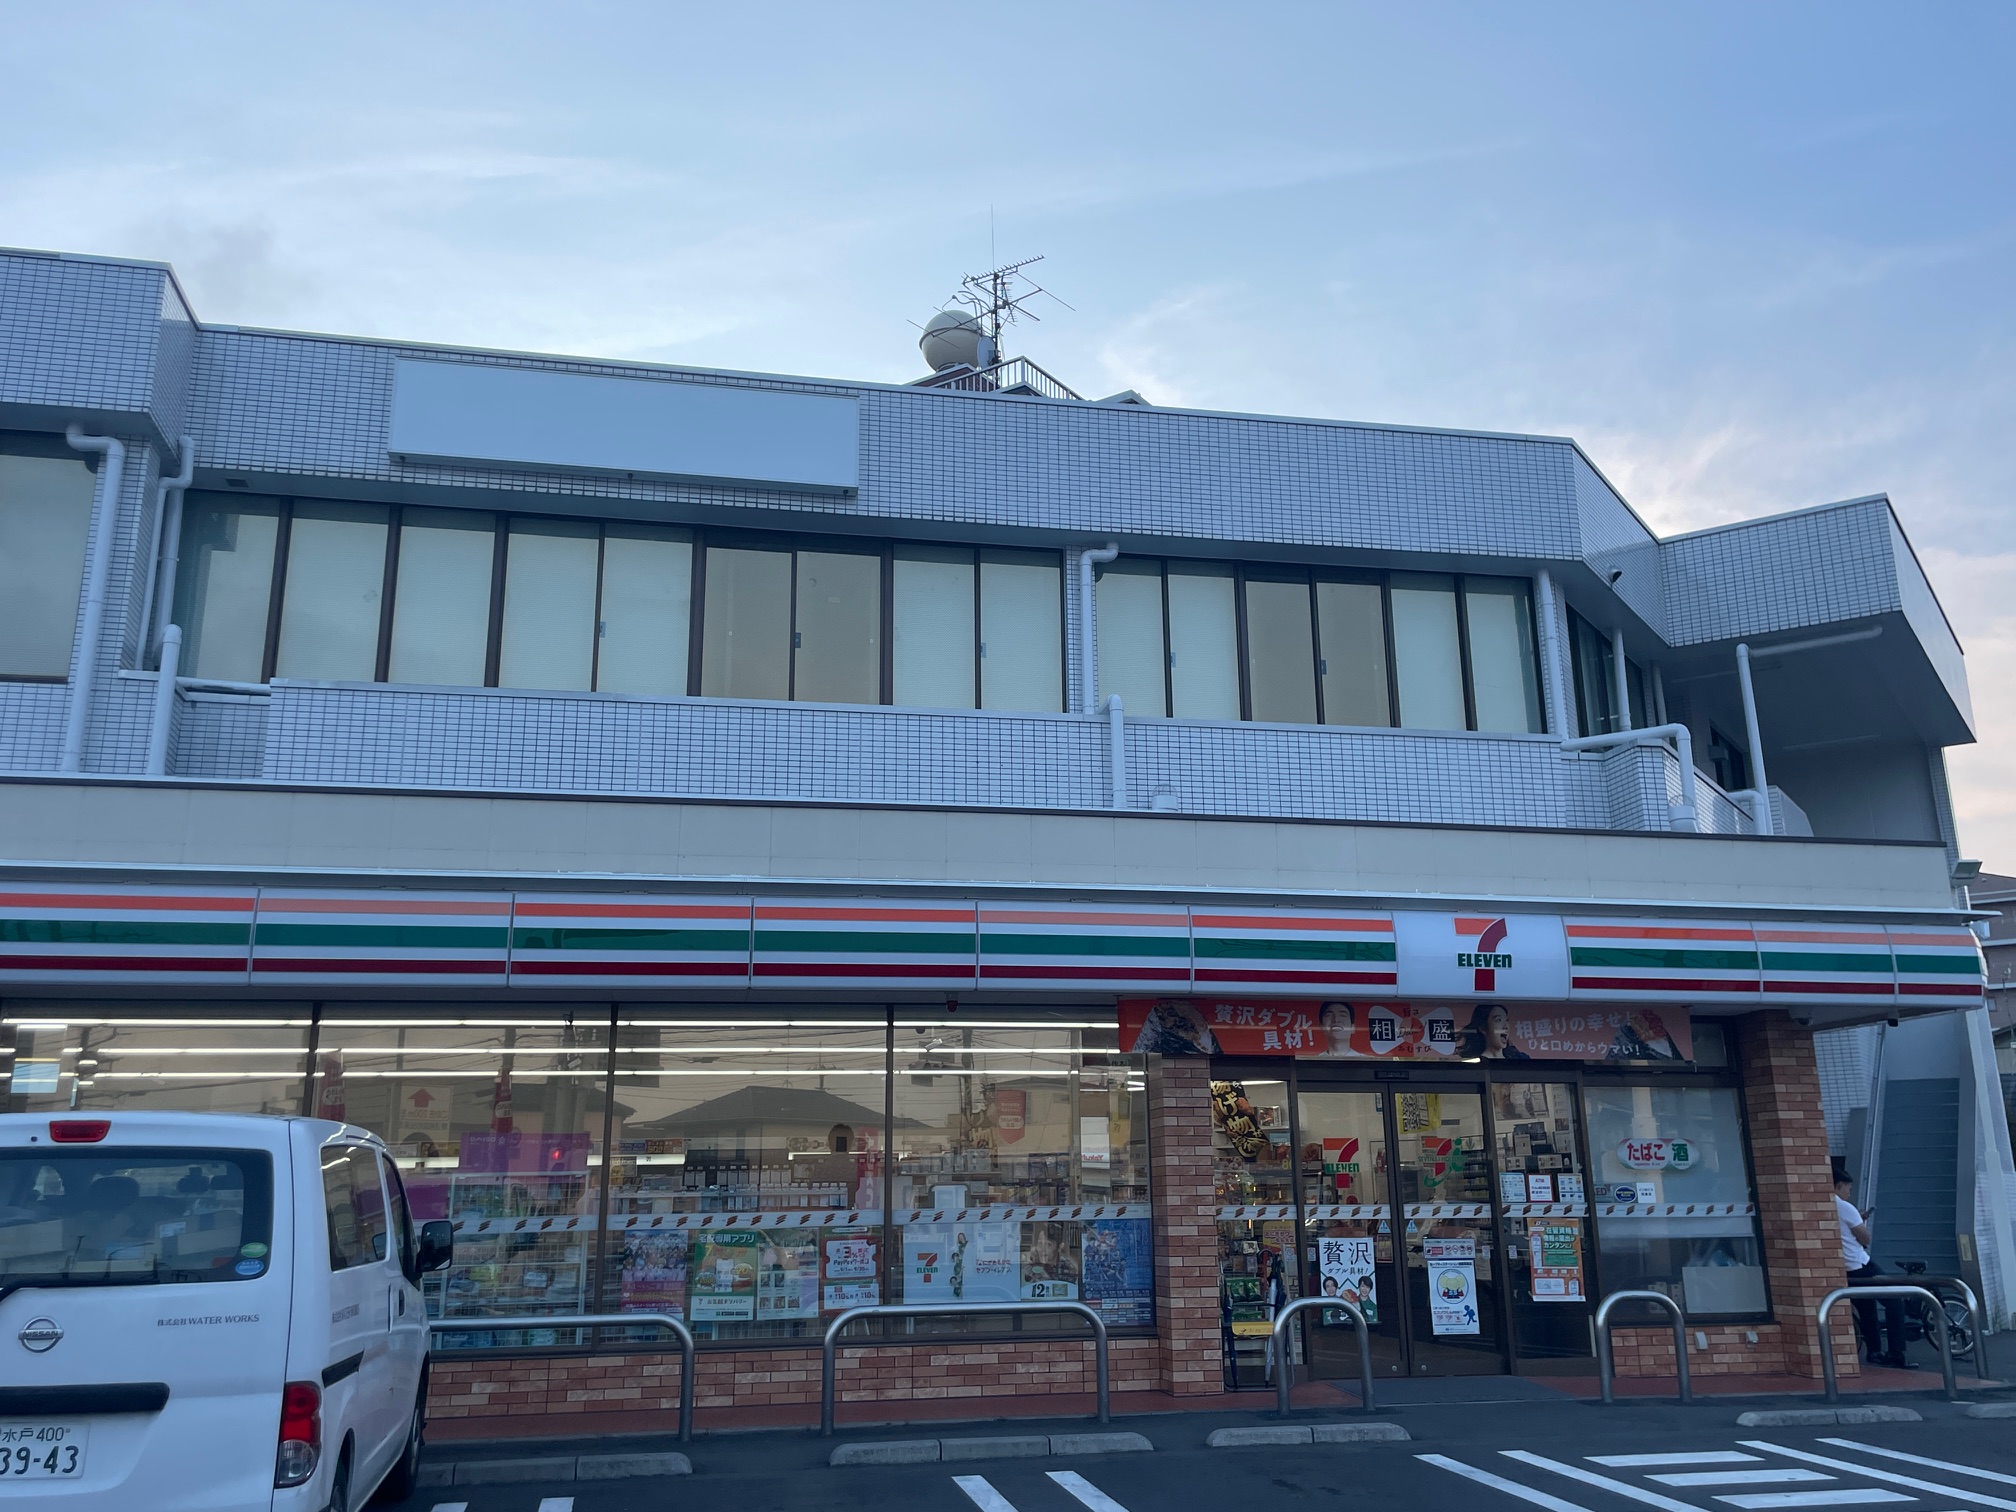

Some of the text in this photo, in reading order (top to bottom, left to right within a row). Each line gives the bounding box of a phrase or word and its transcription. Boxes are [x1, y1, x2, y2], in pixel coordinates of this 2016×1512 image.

[1214, 1003, 1312, 1031] 贅沢ダブル
[1626, 1142, 1665, 1161] たばこ
[1671, 1143, 1689, 1161] 酒
[1322, 1240, 1371, 1265] 贅沢
[188, 1316, 223, 1326] WATER
[225, 1314, 260, 1324] WORKS
[22, 1330, 59, 1338] NISSAN
